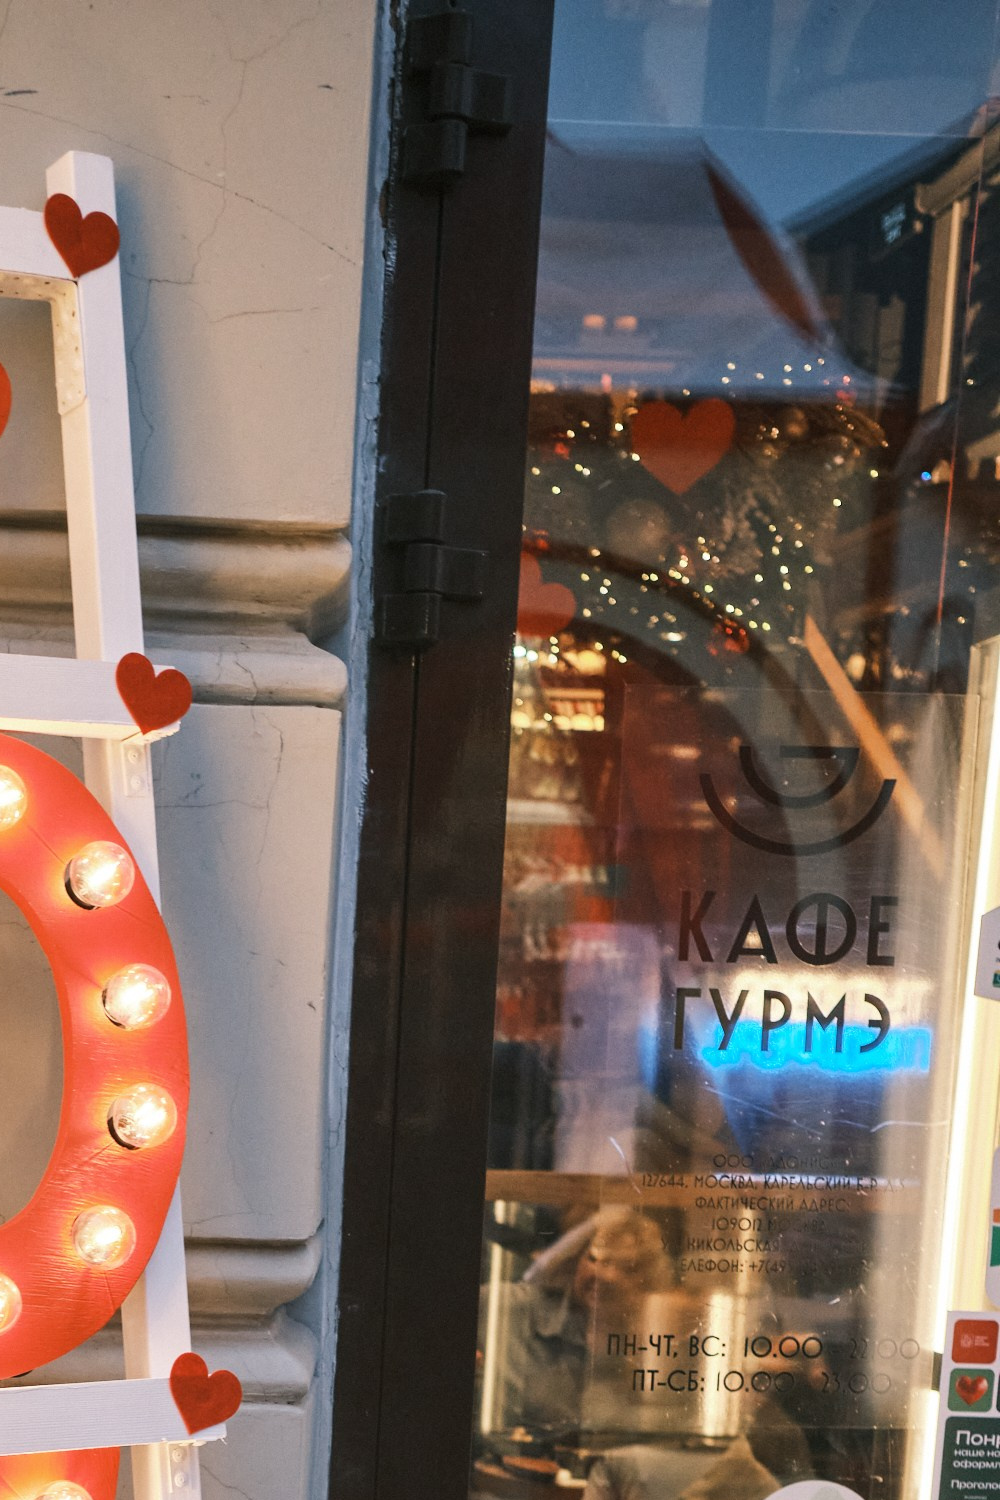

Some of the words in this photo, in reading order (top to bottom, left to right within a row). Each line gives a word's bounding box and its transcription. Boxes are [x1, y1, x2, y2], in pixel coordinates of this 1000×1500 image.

[678, 889, 898, 967] КАФЕ
[673, 987, 892, 1054] ГУРМЭ
[712, 1153, 754, 1169] ООО
[763, 1174, 851, 1192] КАРЕЛЬСКИЙ
[695, 1195, 794, 1211] ФАКТИЧЕСКИЙ
[676, 1258, 744, 1274] ЕЛЕФОН:
[607, 1334, 678, 1358] ПН-ЧТ,
[689, 1335, 726, 1357] ВС:
[743, 1335, 823, 1358] 10.00
[632, 1370, 705, 1392] ПТ-СБ:
[716, 1370, 795, 1392] 10.00
